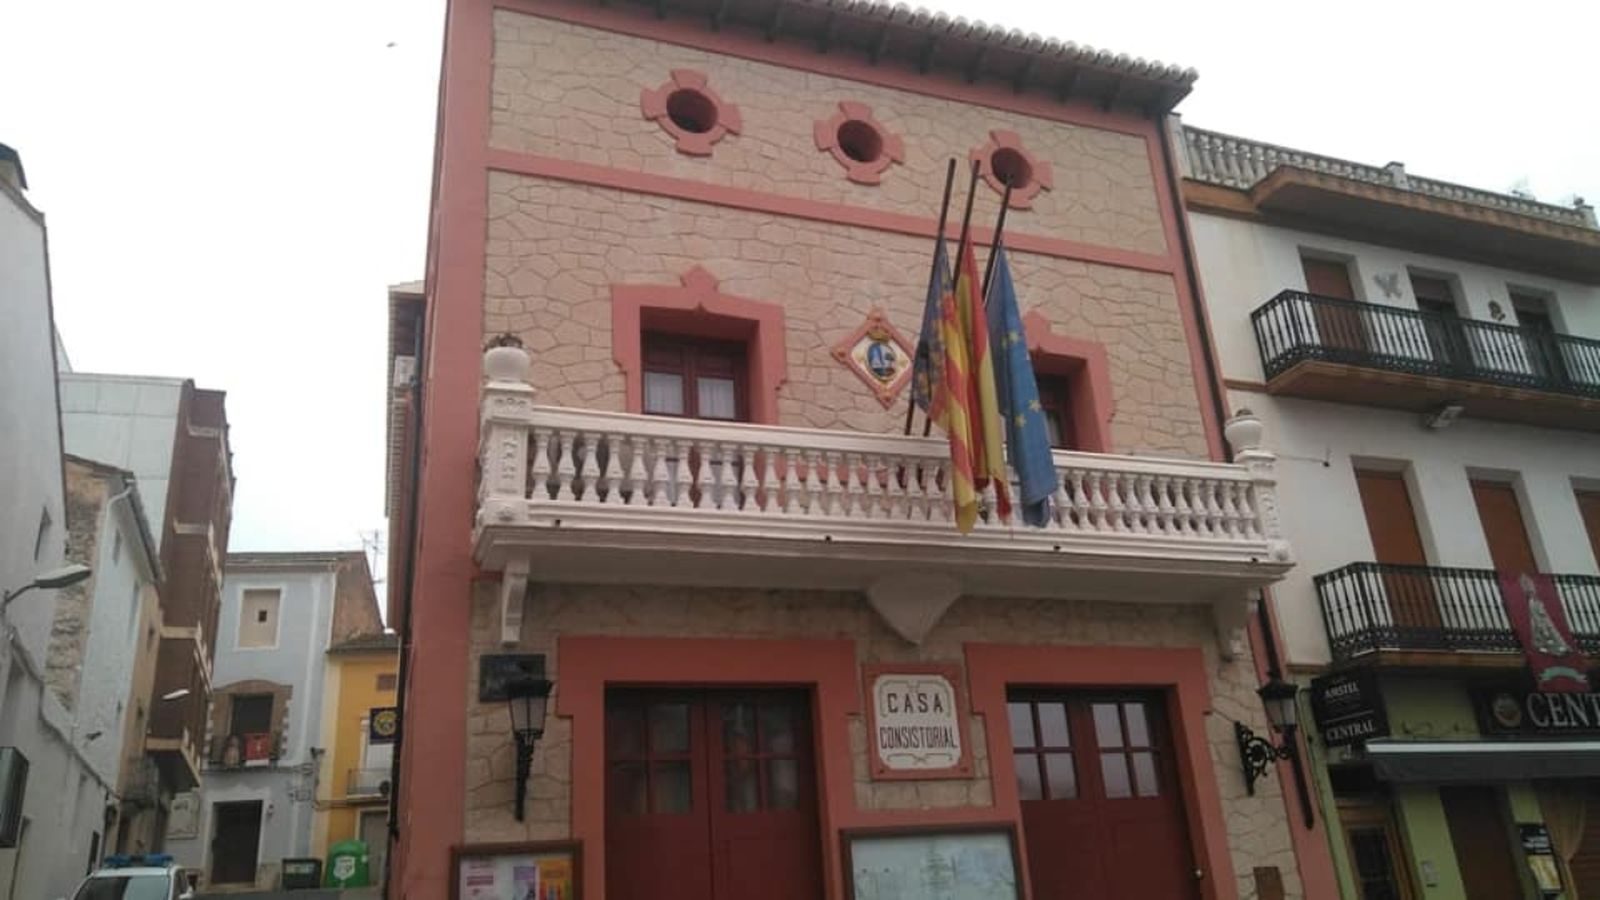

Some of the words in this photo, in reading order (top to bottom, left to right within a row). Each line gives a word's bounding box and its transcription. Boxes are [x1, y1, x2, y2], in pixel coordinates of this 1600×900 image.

[1325, 680, 1361, 698] AMSTEL
[887, 692, 944, 714] CASA
[879, 725, 959, 750] CONSISTORIAL
[1326, 719, 1376, 742] CENTRAL
